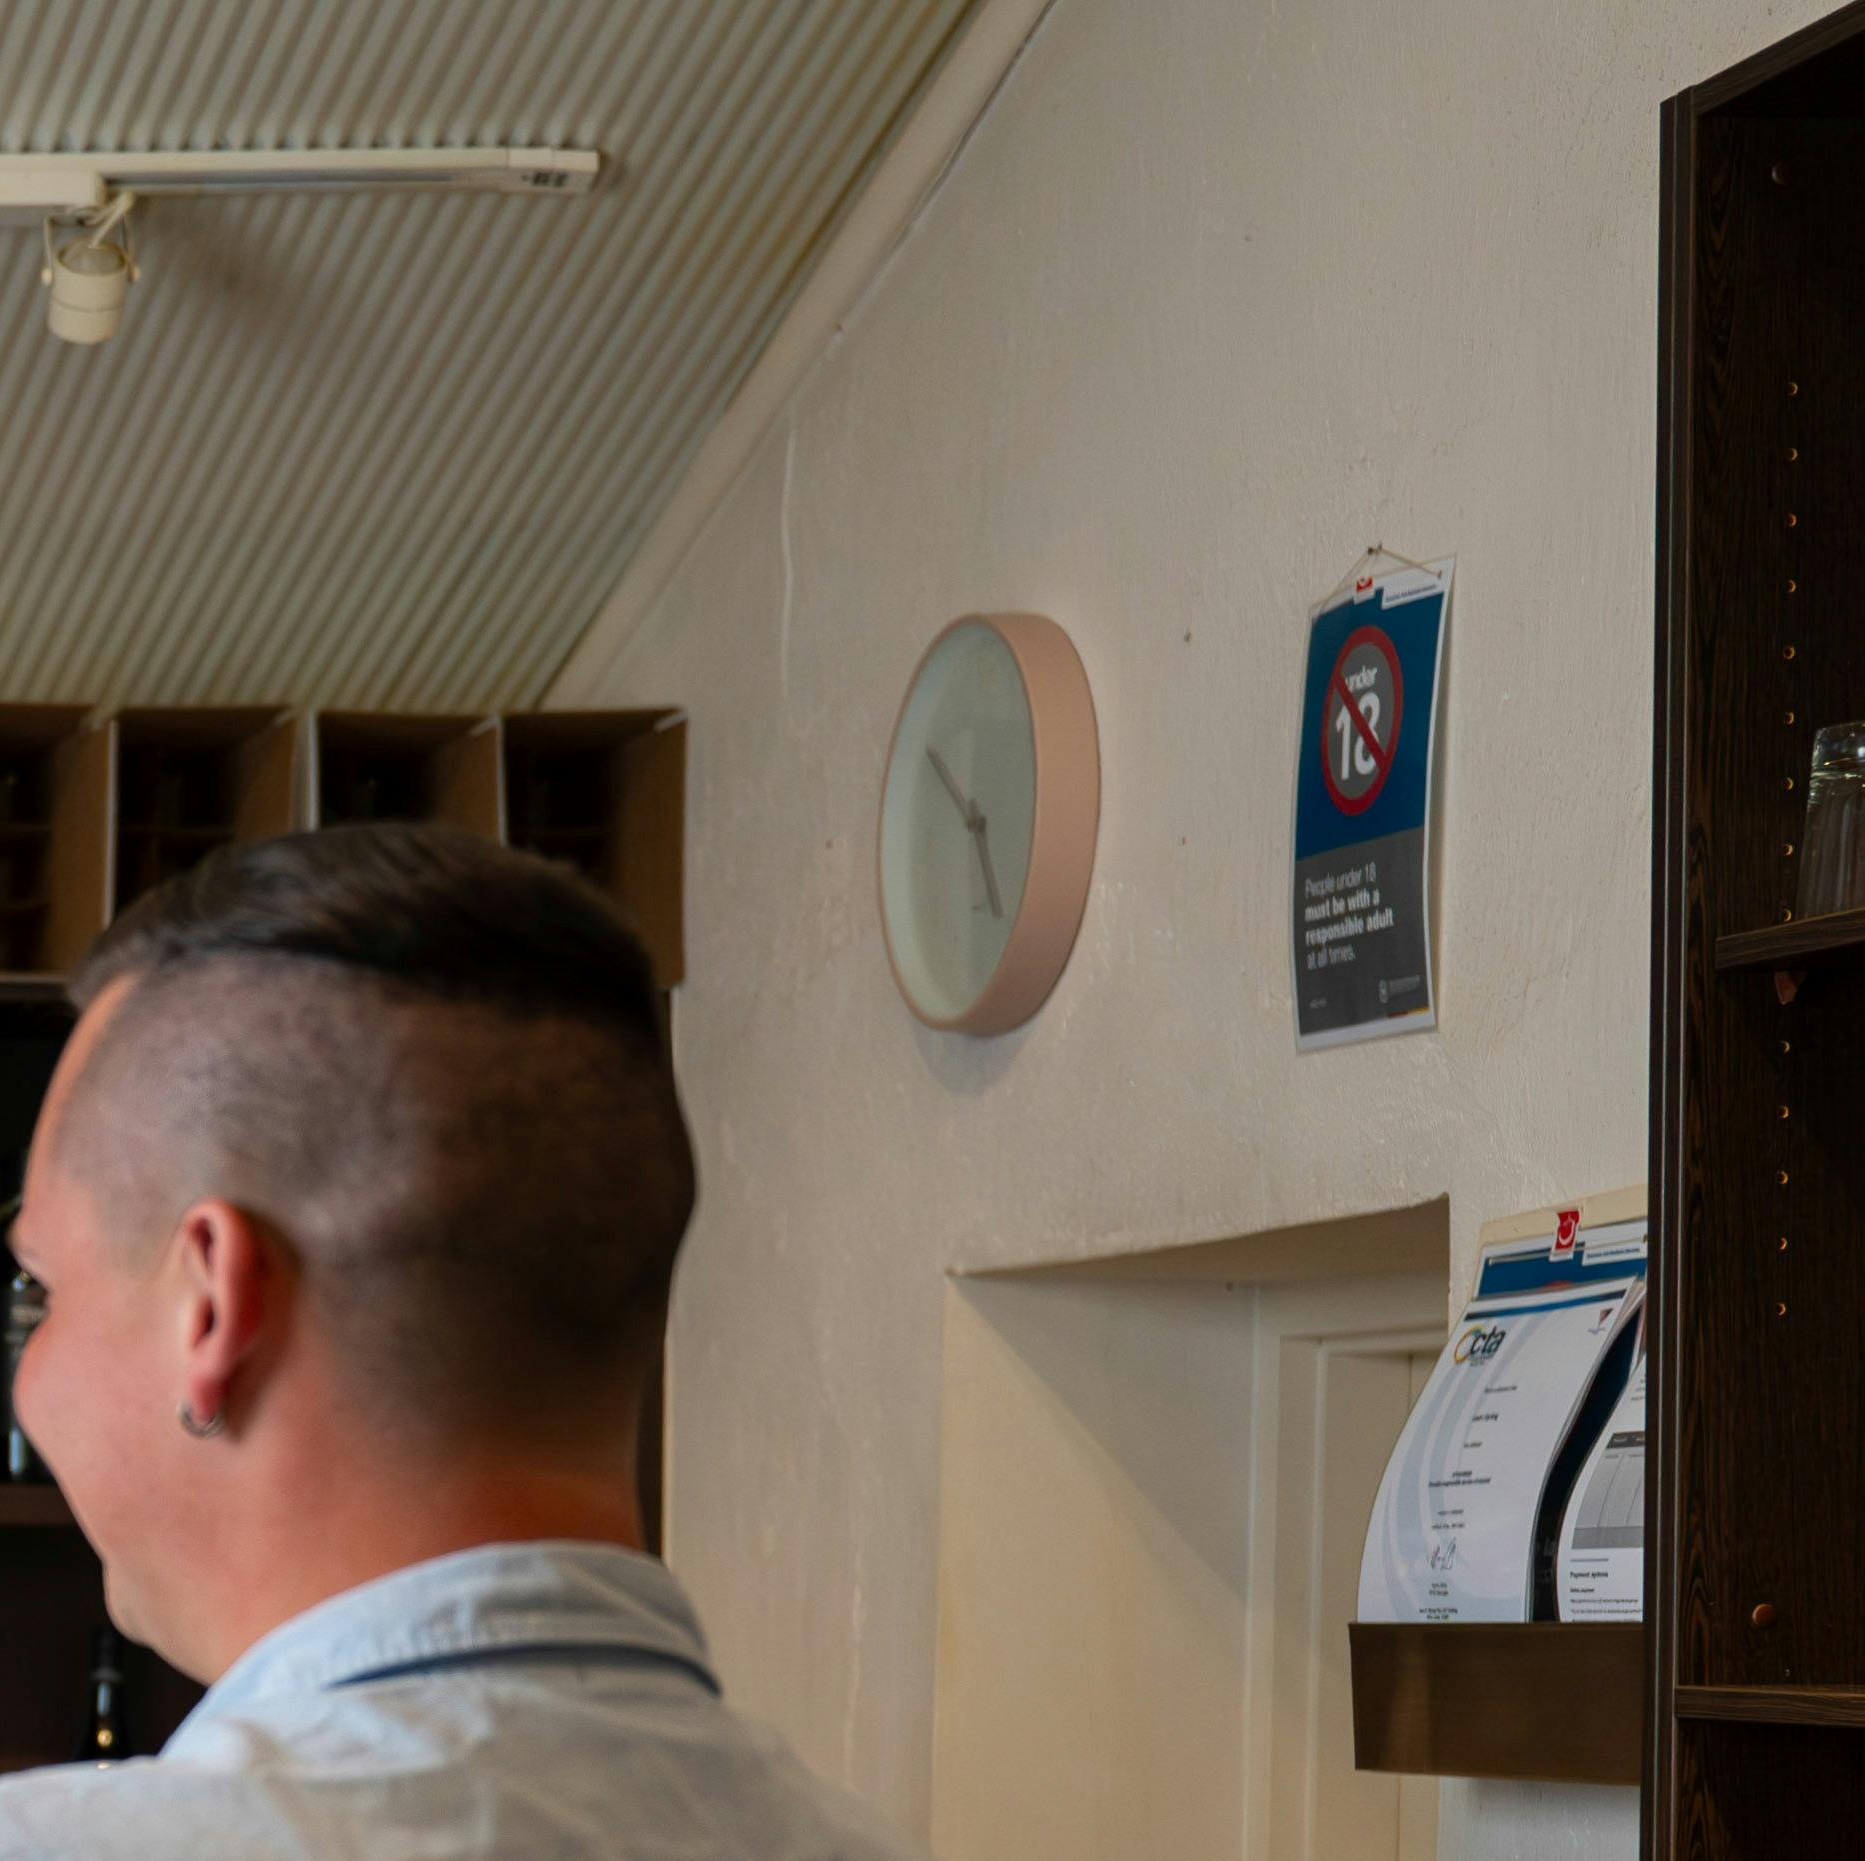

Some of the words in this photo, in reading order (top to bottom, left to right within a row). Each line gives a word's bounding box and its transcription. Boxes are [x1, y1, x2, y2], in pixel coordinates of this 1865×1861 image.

[1344, 664, 1378, 690] under
[1335, 692, 1380, 781] 18
[1305, 875, 1334, 899] People
[1336, 868, 1362, 889] under
[1305, 898, 1330, 922] must
[1333, 895, 1345, 914] be
[1348, 888, 1371, 911] with
[1373, 888, 1380, 905] a
[1306, 916, 1364, 947] responsible
[1366, 908, 1395, 932] adult
